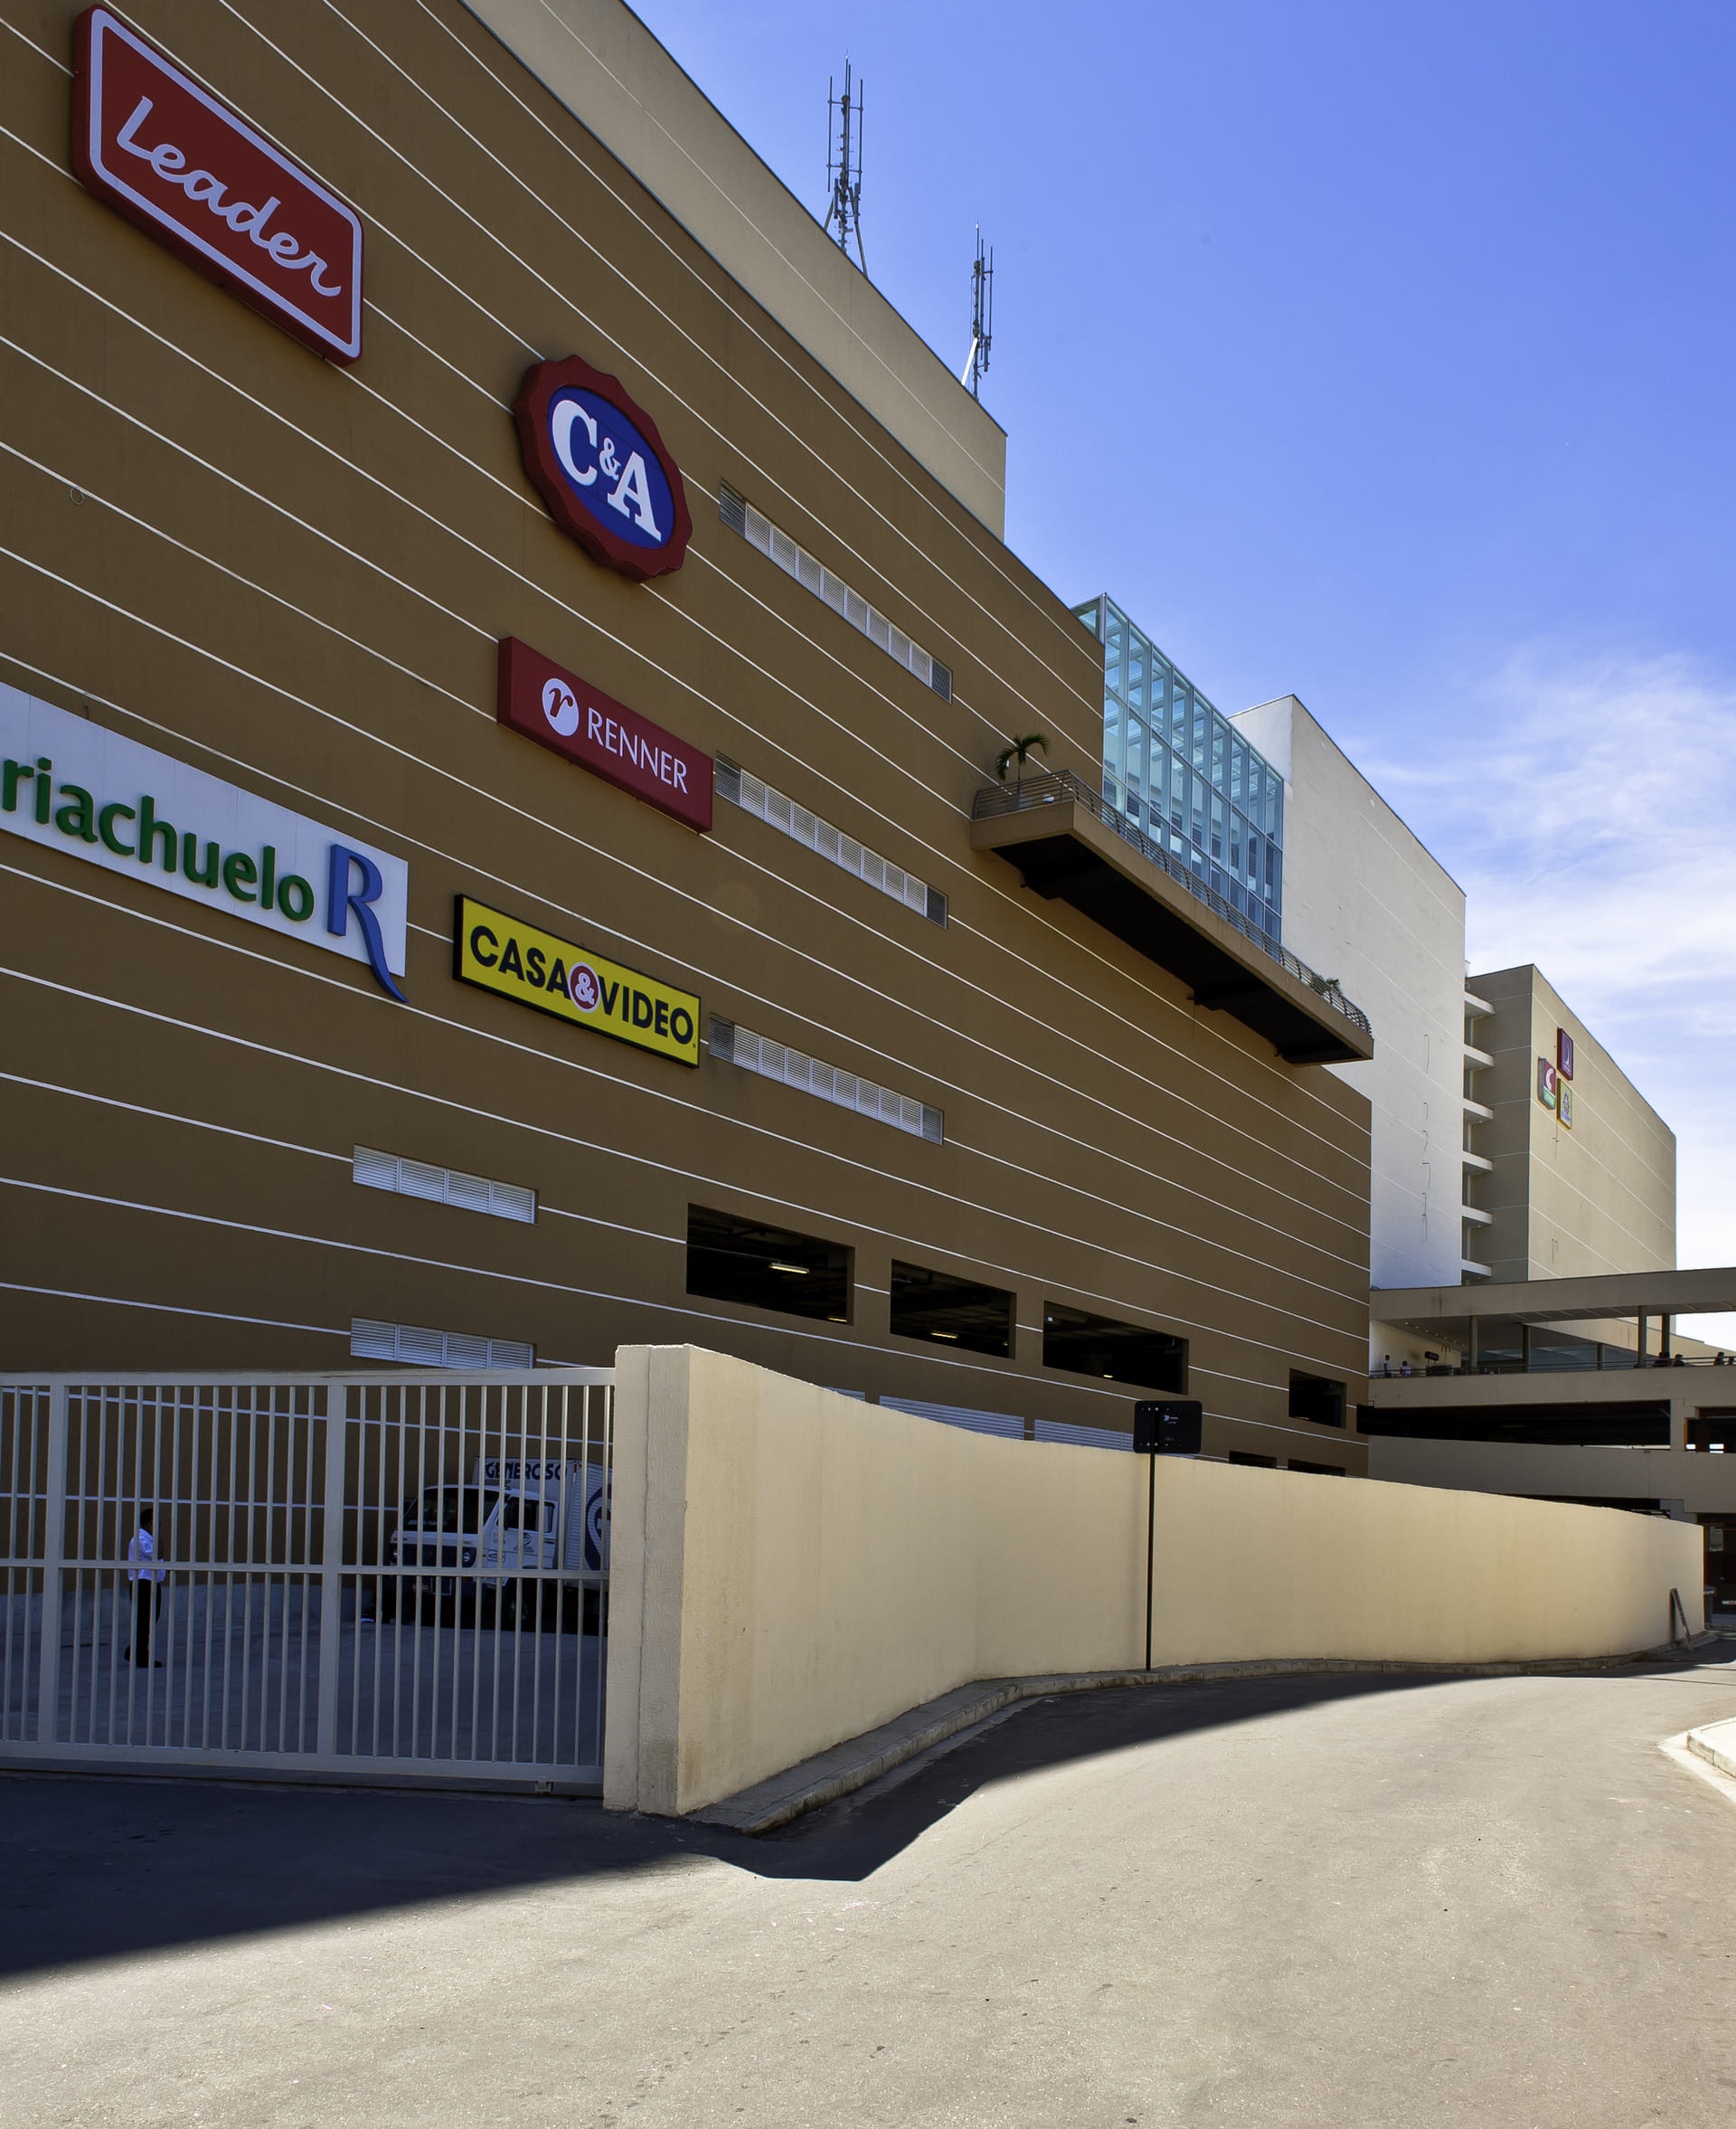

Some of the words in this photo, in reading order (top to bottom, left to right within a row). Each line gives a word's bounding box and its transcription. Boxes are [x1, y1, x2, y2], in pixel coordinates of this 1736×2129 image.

[117, 96, 341, 297] Leader
[552, 399, 662, 542] C&A
[588, 707, 688, 794] RENNER
[3, 757, 315, 921] riachuelo
